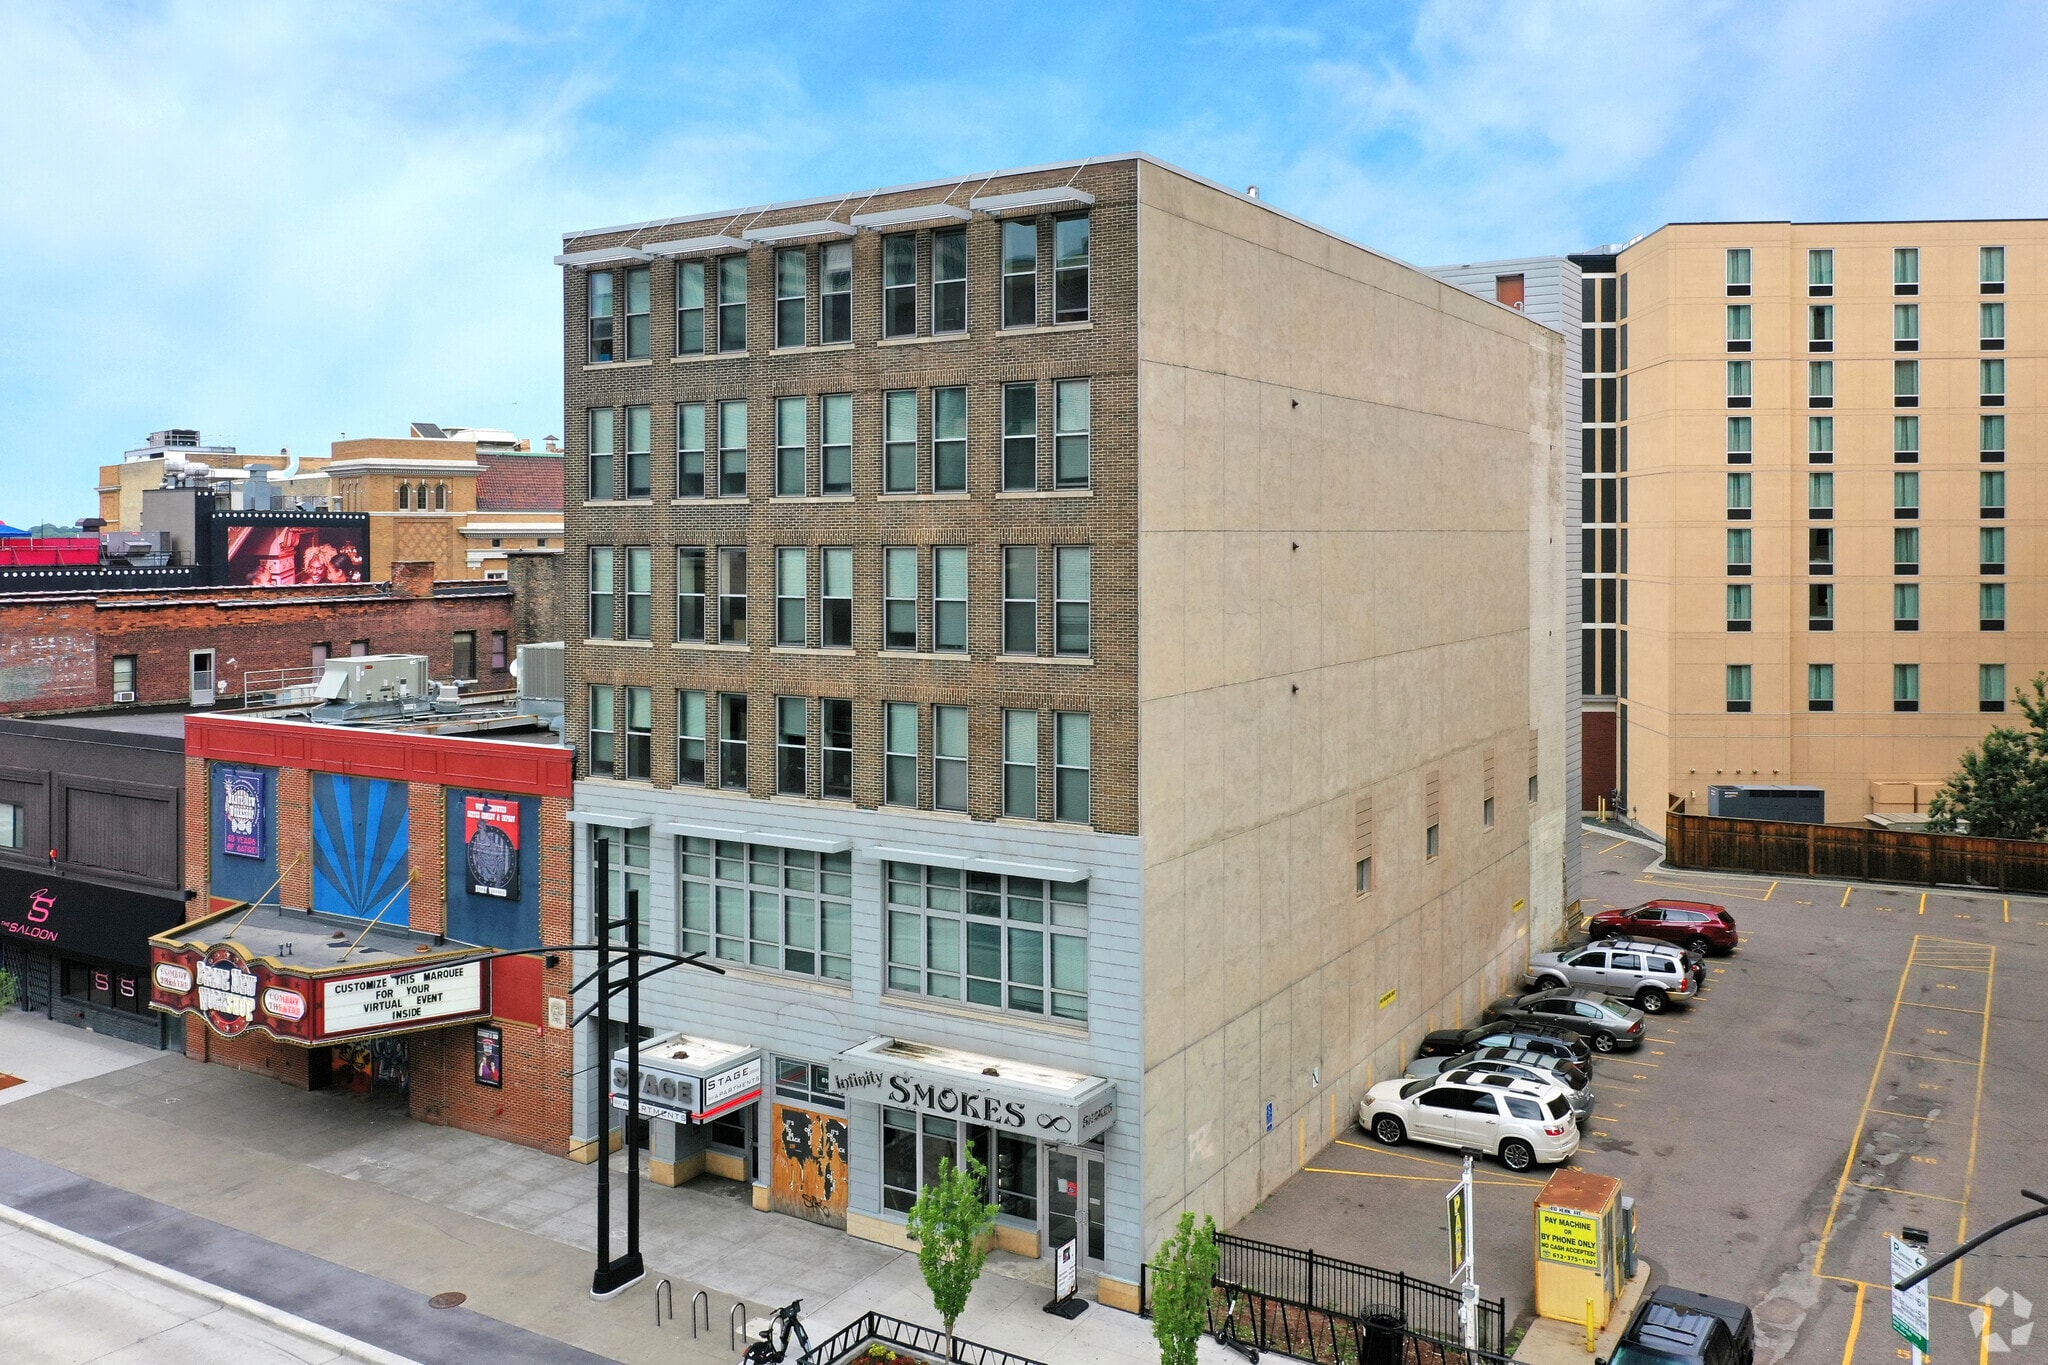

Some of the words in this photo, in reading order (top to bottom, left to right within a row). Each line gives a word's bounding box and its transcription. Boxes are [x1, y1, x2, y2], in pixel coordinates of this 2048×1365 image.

[9, 922, 59, 941] SALOON
[160, 967, 188, 980] COMEDY
[160, 976, 189, 989] THEATRE
[335, 978, 387, 994] CUSTOMIZE
[396, 974, 415, 986] THIS
[424, 968, 464, 982] MARQUEE
[269, 992, 300, 1006] COMEDY
[376, 989, 393, 1000] FOR
[406, 984, 430, 996] YOUR
[269, 1002, 301, 1016] THEATRE
[364, 999, 403, 1013] VIRTUAL
[417, 993, 443, 1005] EVENT
[392, 1007, 421, 1020] INSIDE
[613, 1067, 692, 1104] SAGE
[707, 1067, 749, 1091] STAGE
[713, 1076, 760, 1099] APARTMENTS
[835, 1070, 884, 1091] Infinity
[889, 1072, 1026, 1128] SMOKES
[622, 1102, 687, 1123] ARTMENTS
[1544, 1216, 1557, 1225] PAY
[1559, 1219, 1591, 1231] MACHINE
[1541, 1232, 1550, 1240] BY
[1552, 1235, 1576, 1245] PHONE
[1577, 1240, 1596, 1249] ONLY
